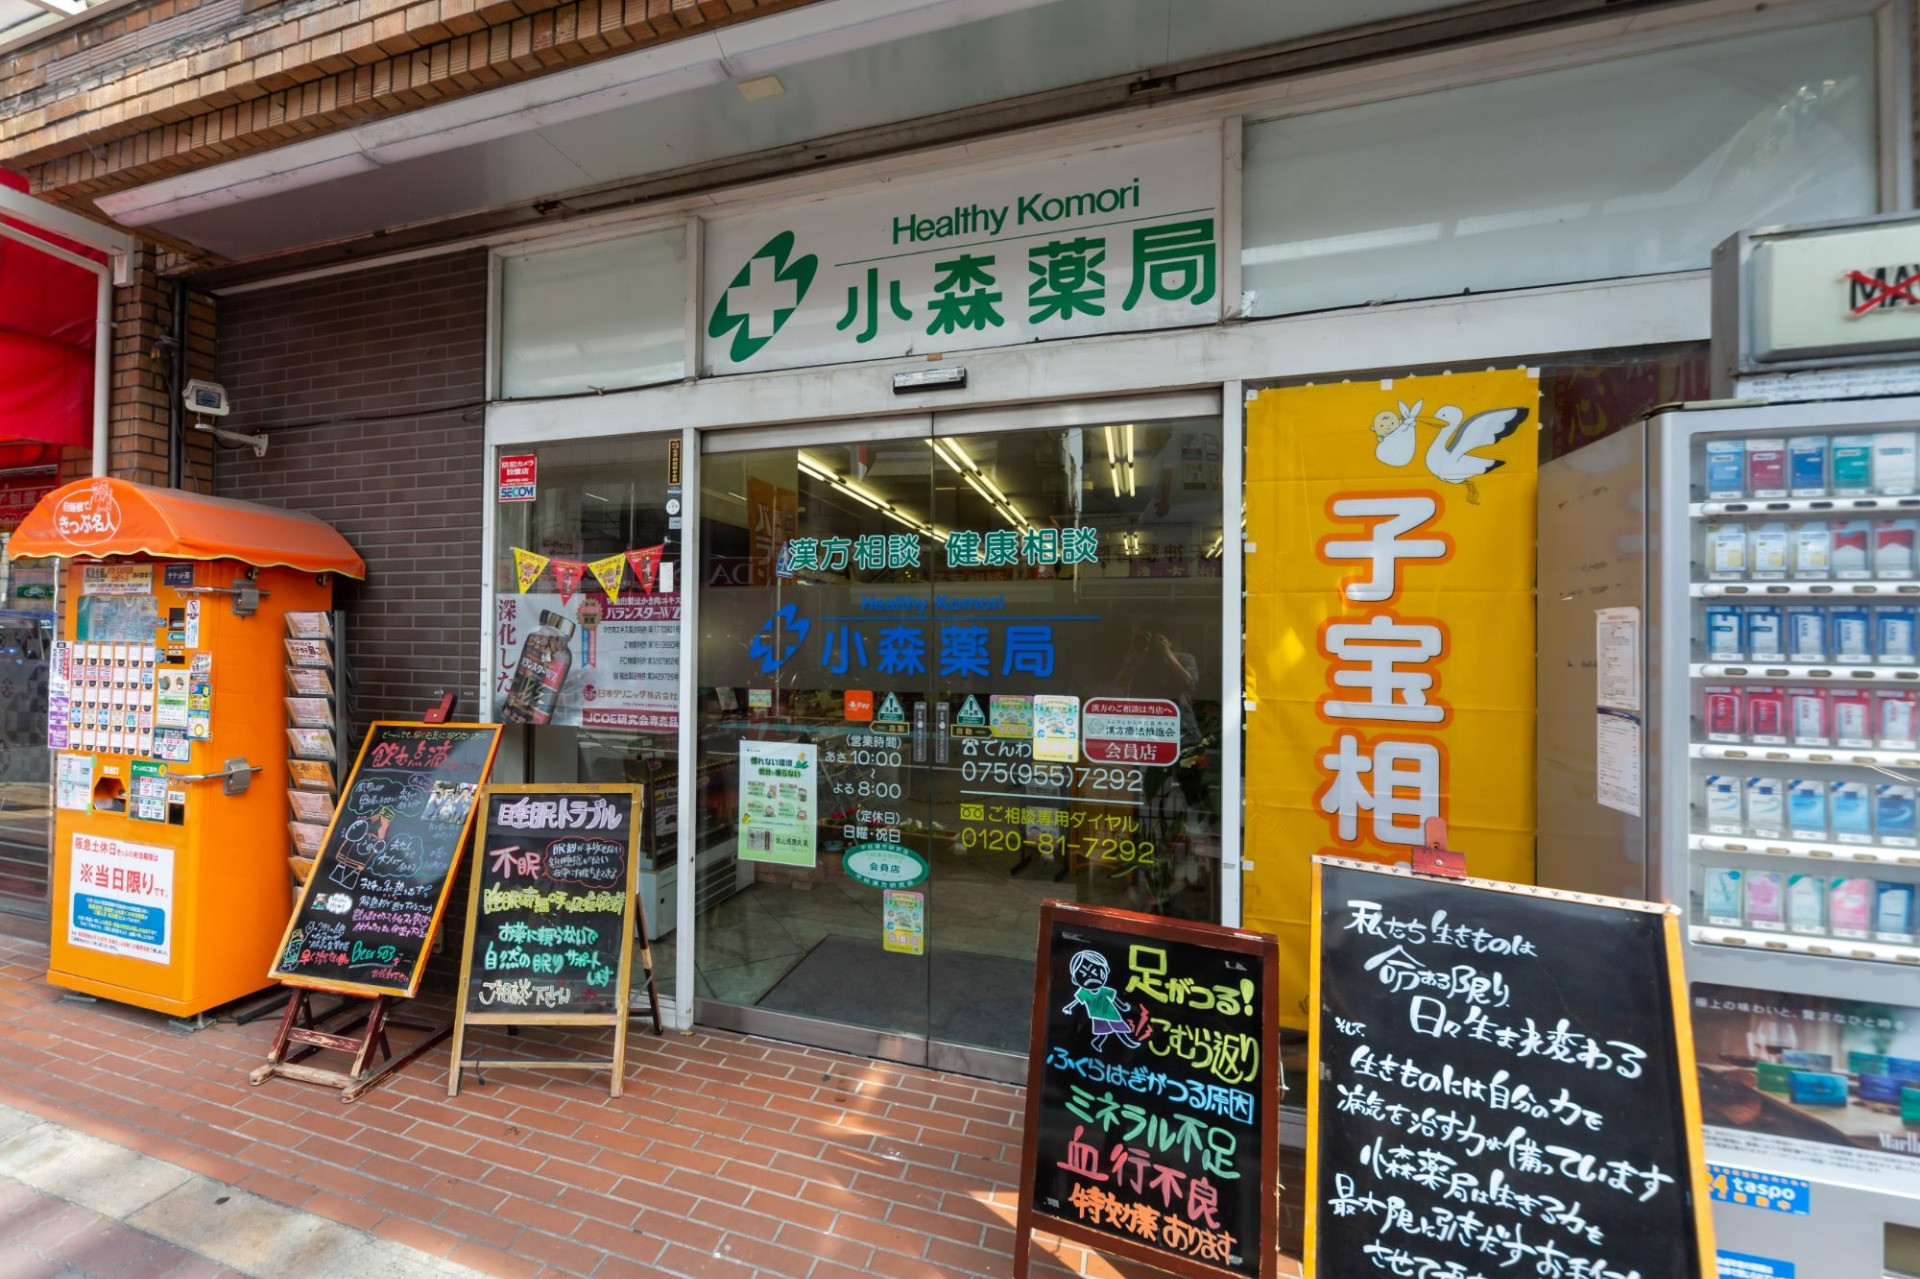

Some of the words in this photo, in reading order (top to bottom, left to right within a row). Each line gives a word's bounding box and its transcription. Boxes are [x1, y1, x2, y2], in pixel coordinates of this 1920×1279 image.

[892, 204, 1009, 245] Healthy
[1018, 178, 1139, 226] Komori
[836, 218, 1216, 344] 小森薬局
[1851, 264, 1920, 312] MA
[501, 487, 534, 498] SECOM
[788, 534, 921, 570] 漢方相談
[944, 527, 1099, 567] 健康相談
[861, 594, 929, 614] Healthy
[935, 594, 1005, 611] Komori
[820, 625, 1055, 678] 小森薬局
[1320, 497, 1447, 868] 子宝相
[857, 702, 870, 711] Pay
[1091, 703, 1173, 715] 漢方のご相談は当店へ
[1105, 726, 1176, 738] 漢方療法推進会
[824, 752, 847, 764] あさ
[850, 750, 902, 768] 10:00
[981, 740, 1032, 758] でんわ
[1104, 742, 1158, 761] 会員店
[833, 783, 855, 795] よる
[858, 781, 901, 799] 8:00
[961, 761, 1144, 792] 075(955)7292
[498, 797, 622, 829] 睡眠トラブル
[988, 805, 1140, 834] ご相談専用ダイヤル
[961, 827, 1155, 865] 0120-81-7292
[489, 846, 541, 880] 不眠
[869, 862, 901, 874] 会員店
[498, 921, 599, 947] お薬に頼らないで
[484, 941, 602, 974] 自然の眠りサポート
[479, 978, 571, 1008] ご相談下さい
[586, 965, 614, 988] します
[1125, 944, 1255, 1016] 足がつる!
[1148, 1018, 1259, 1084] こむら返り
[1409, 995, 1648, 1080] 日々生まれ変わる
[1046, 1046, 1255, 1125] ふくらはぎがつる原因
[1349, 1044, 1604, 1132] 生きものには自分の力で
[1065, 1085, 1241, 1180] ミネラル不足
[1336, 1083, 1676, 1202] 病気を治す力が備っています
[1056, 1125, 1220, 1229] 血行不良
[1359, 1136, 1606, 1245] 小森薬局は生きる力を
[1732, 1177, 1796, 1200] taspo
[1068, 1182, 1238, 1265] 特効薬あります
